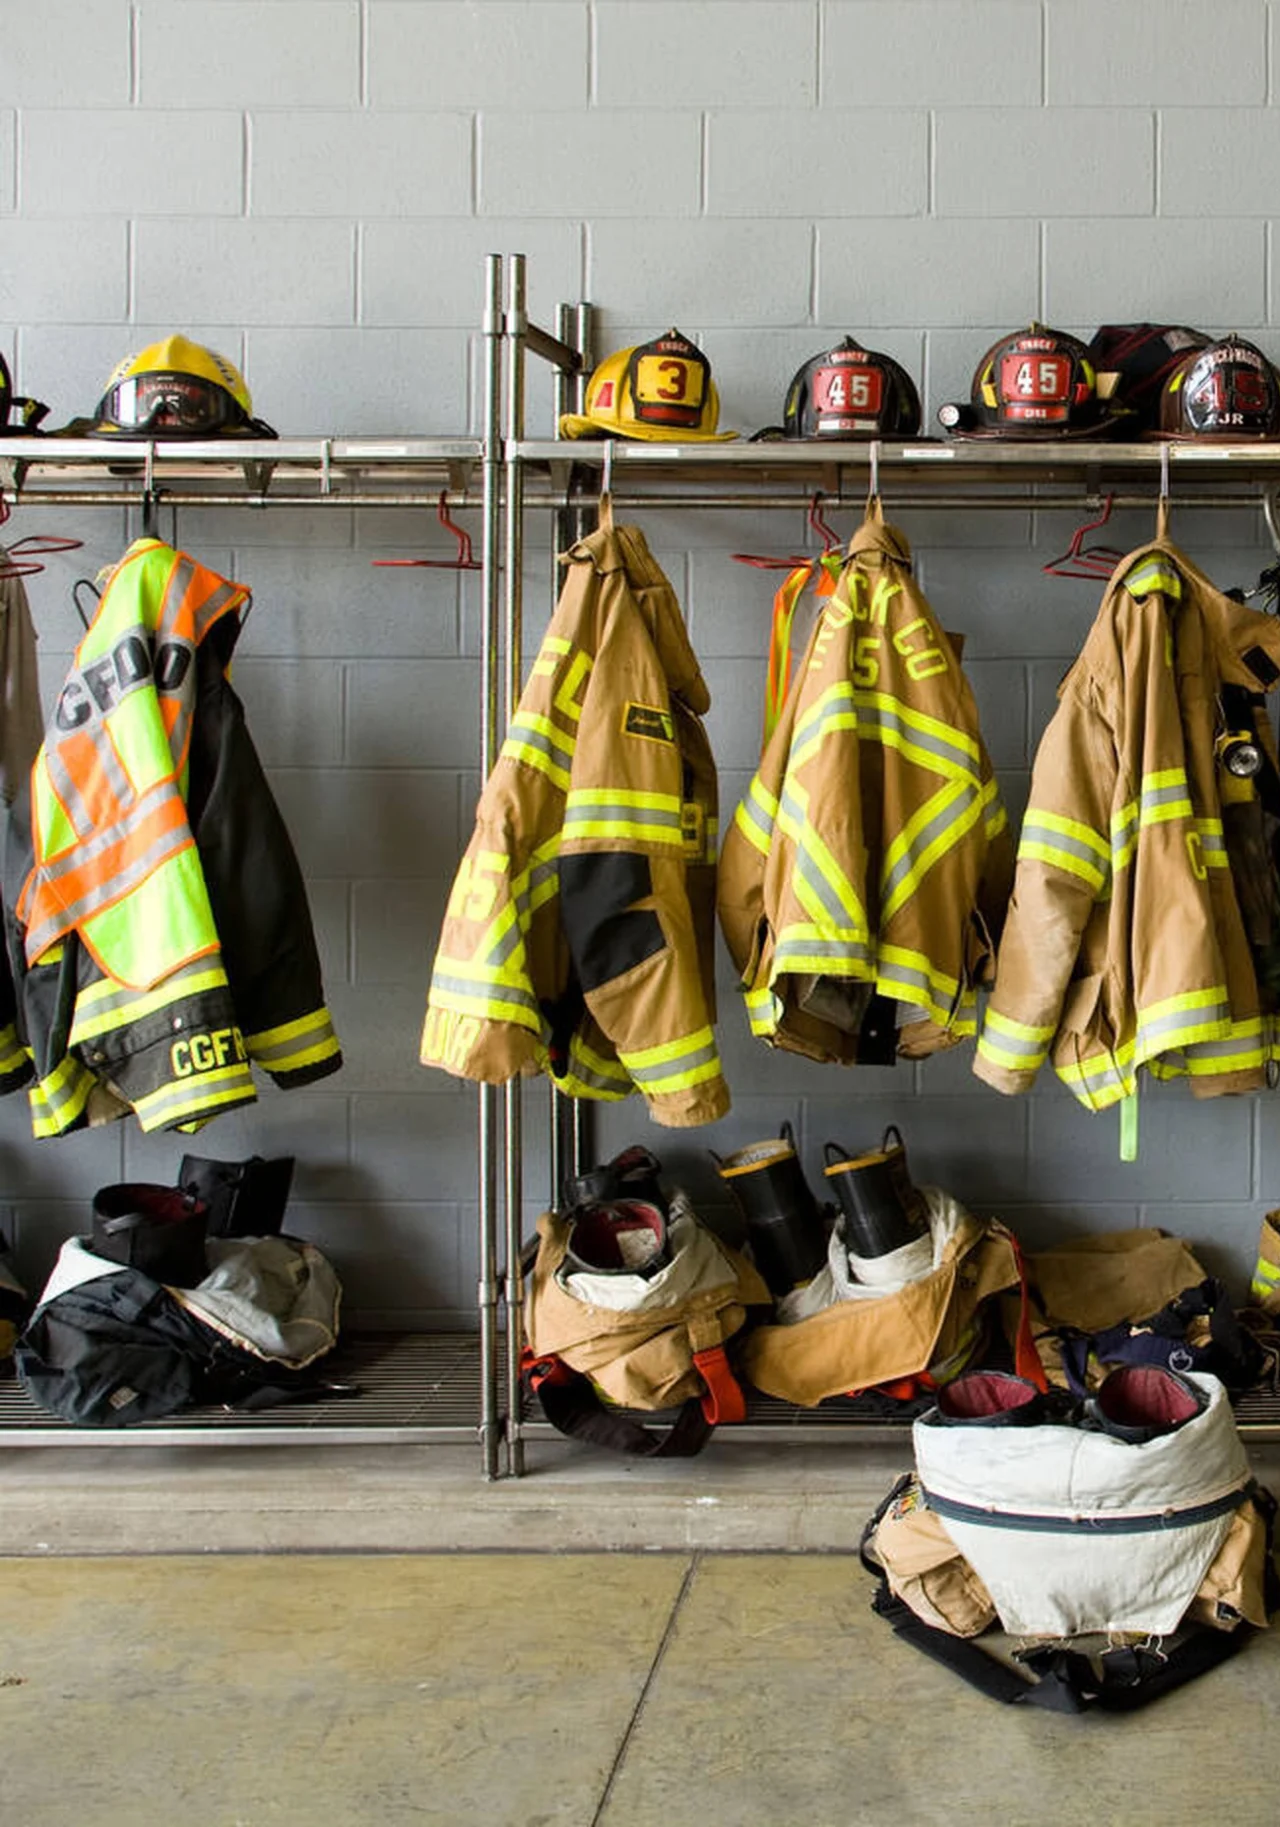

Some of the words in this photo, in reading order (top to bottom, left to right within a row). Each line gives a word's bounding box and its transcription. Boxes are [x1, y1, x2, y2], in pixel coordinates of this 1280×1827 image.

[656, 361, 688, 400] 3
[829, 374, 870, 406] 45
[1016, 362, 1058, 394] 45
[852, 637, 881, 687] 5
[893, 617, 949, 681] CO
